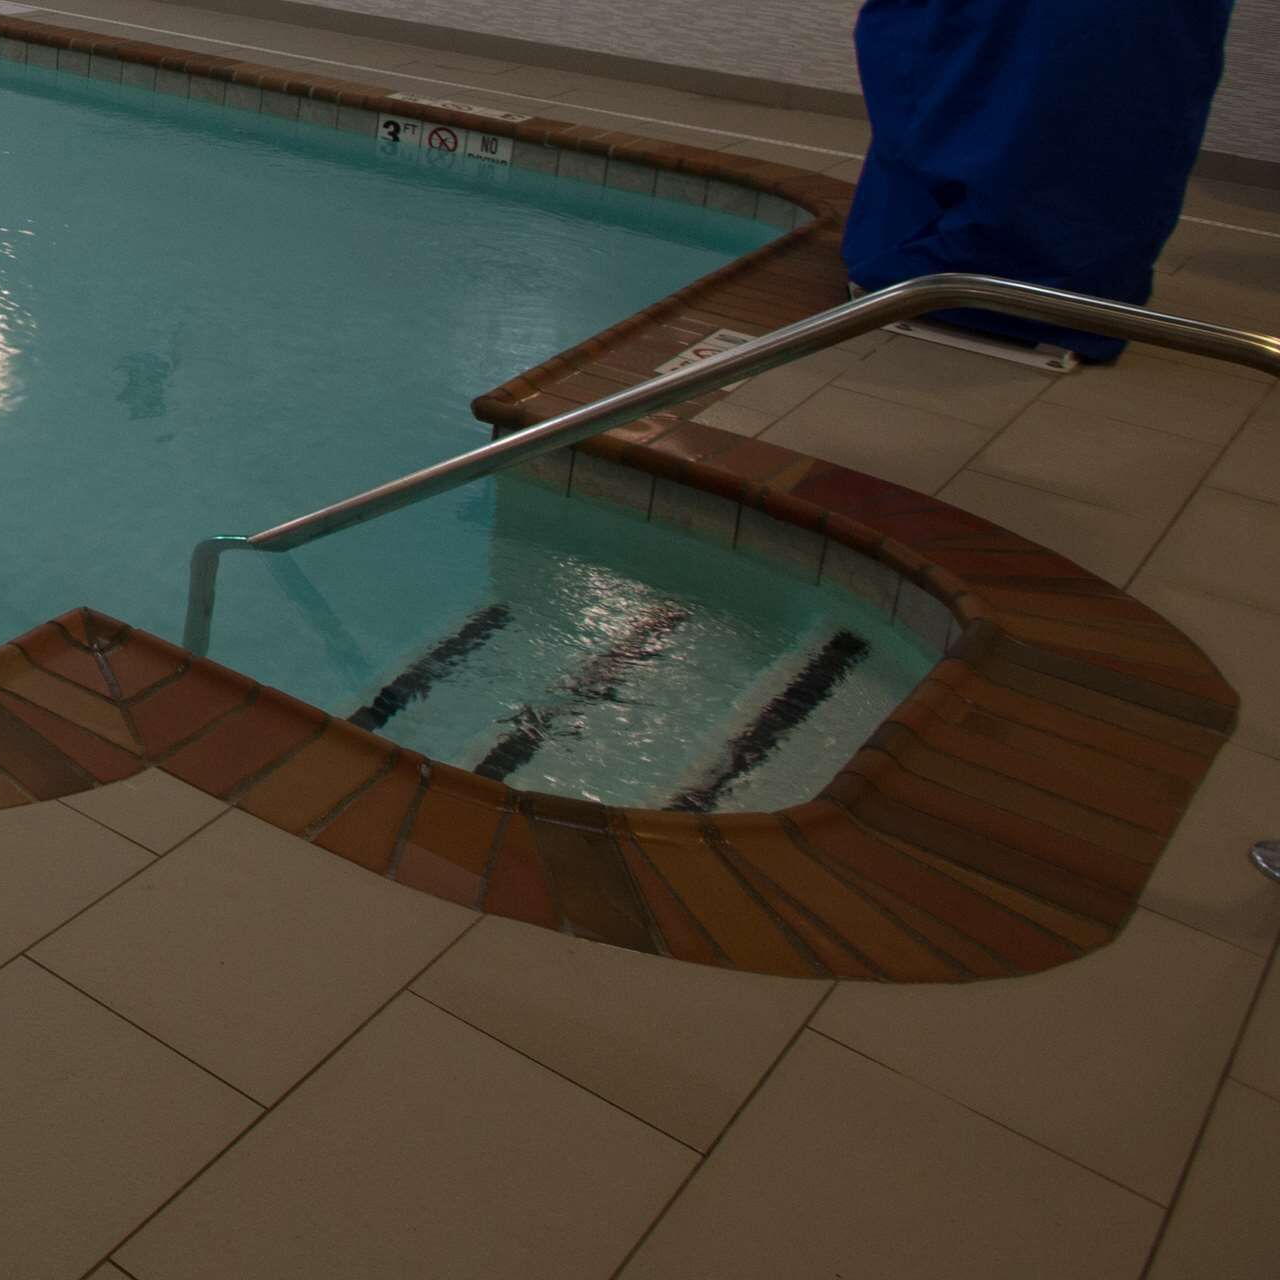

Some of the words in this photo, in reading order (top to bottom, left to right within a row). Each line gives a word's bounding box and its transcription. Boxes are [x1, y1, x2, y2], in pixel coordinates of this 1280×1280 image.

[383, 120, 401, 142] 3
[403, 124, 418, 135] FT
[480, 135, 498, 154] NO
